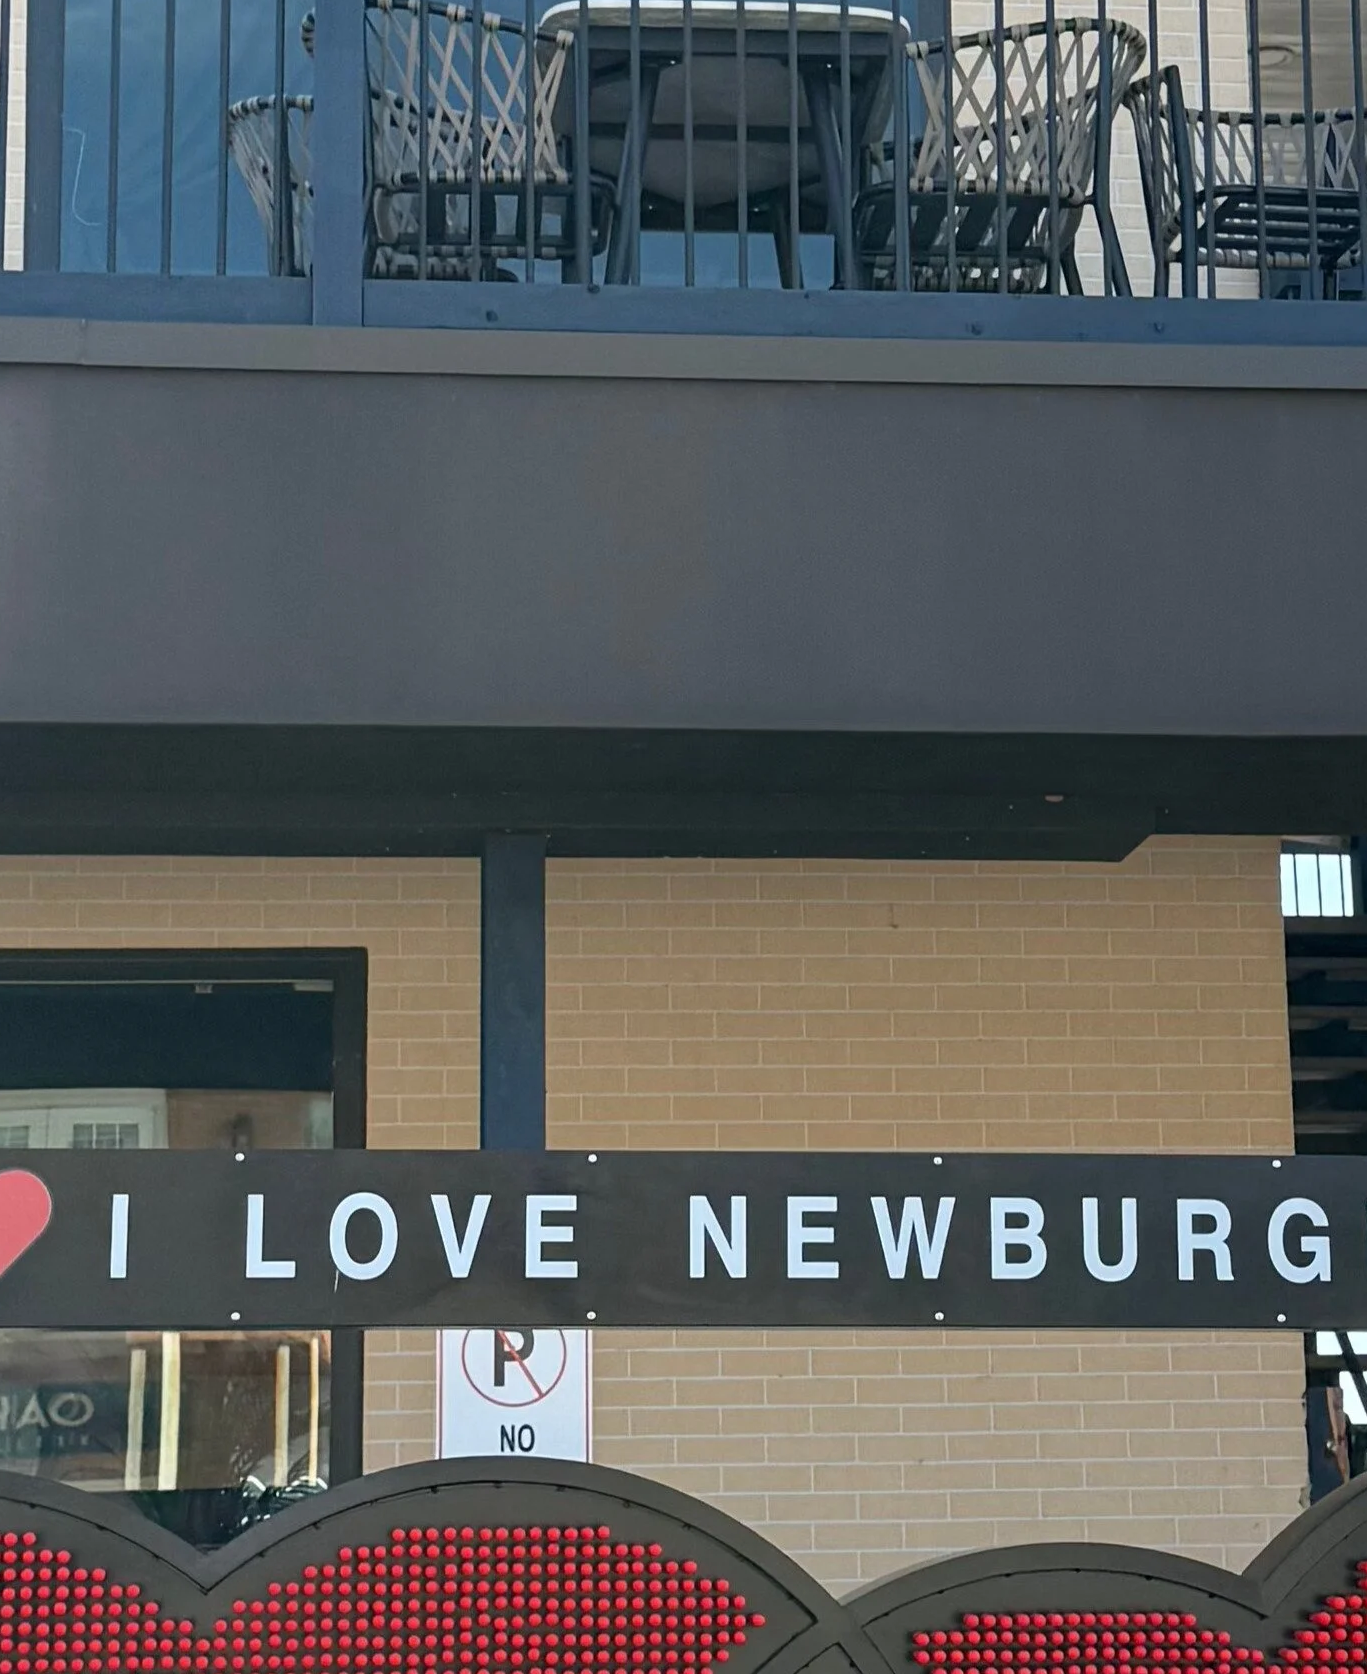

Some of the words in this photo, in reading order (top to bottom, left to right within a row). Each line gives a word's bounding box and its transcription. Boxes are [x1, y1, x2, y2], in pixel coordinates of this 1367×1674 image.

[111, 1194, 129, 1278] I
[246, 1193, 577, 1279] LOVE
[500, 1423, 536, 1453] NO
